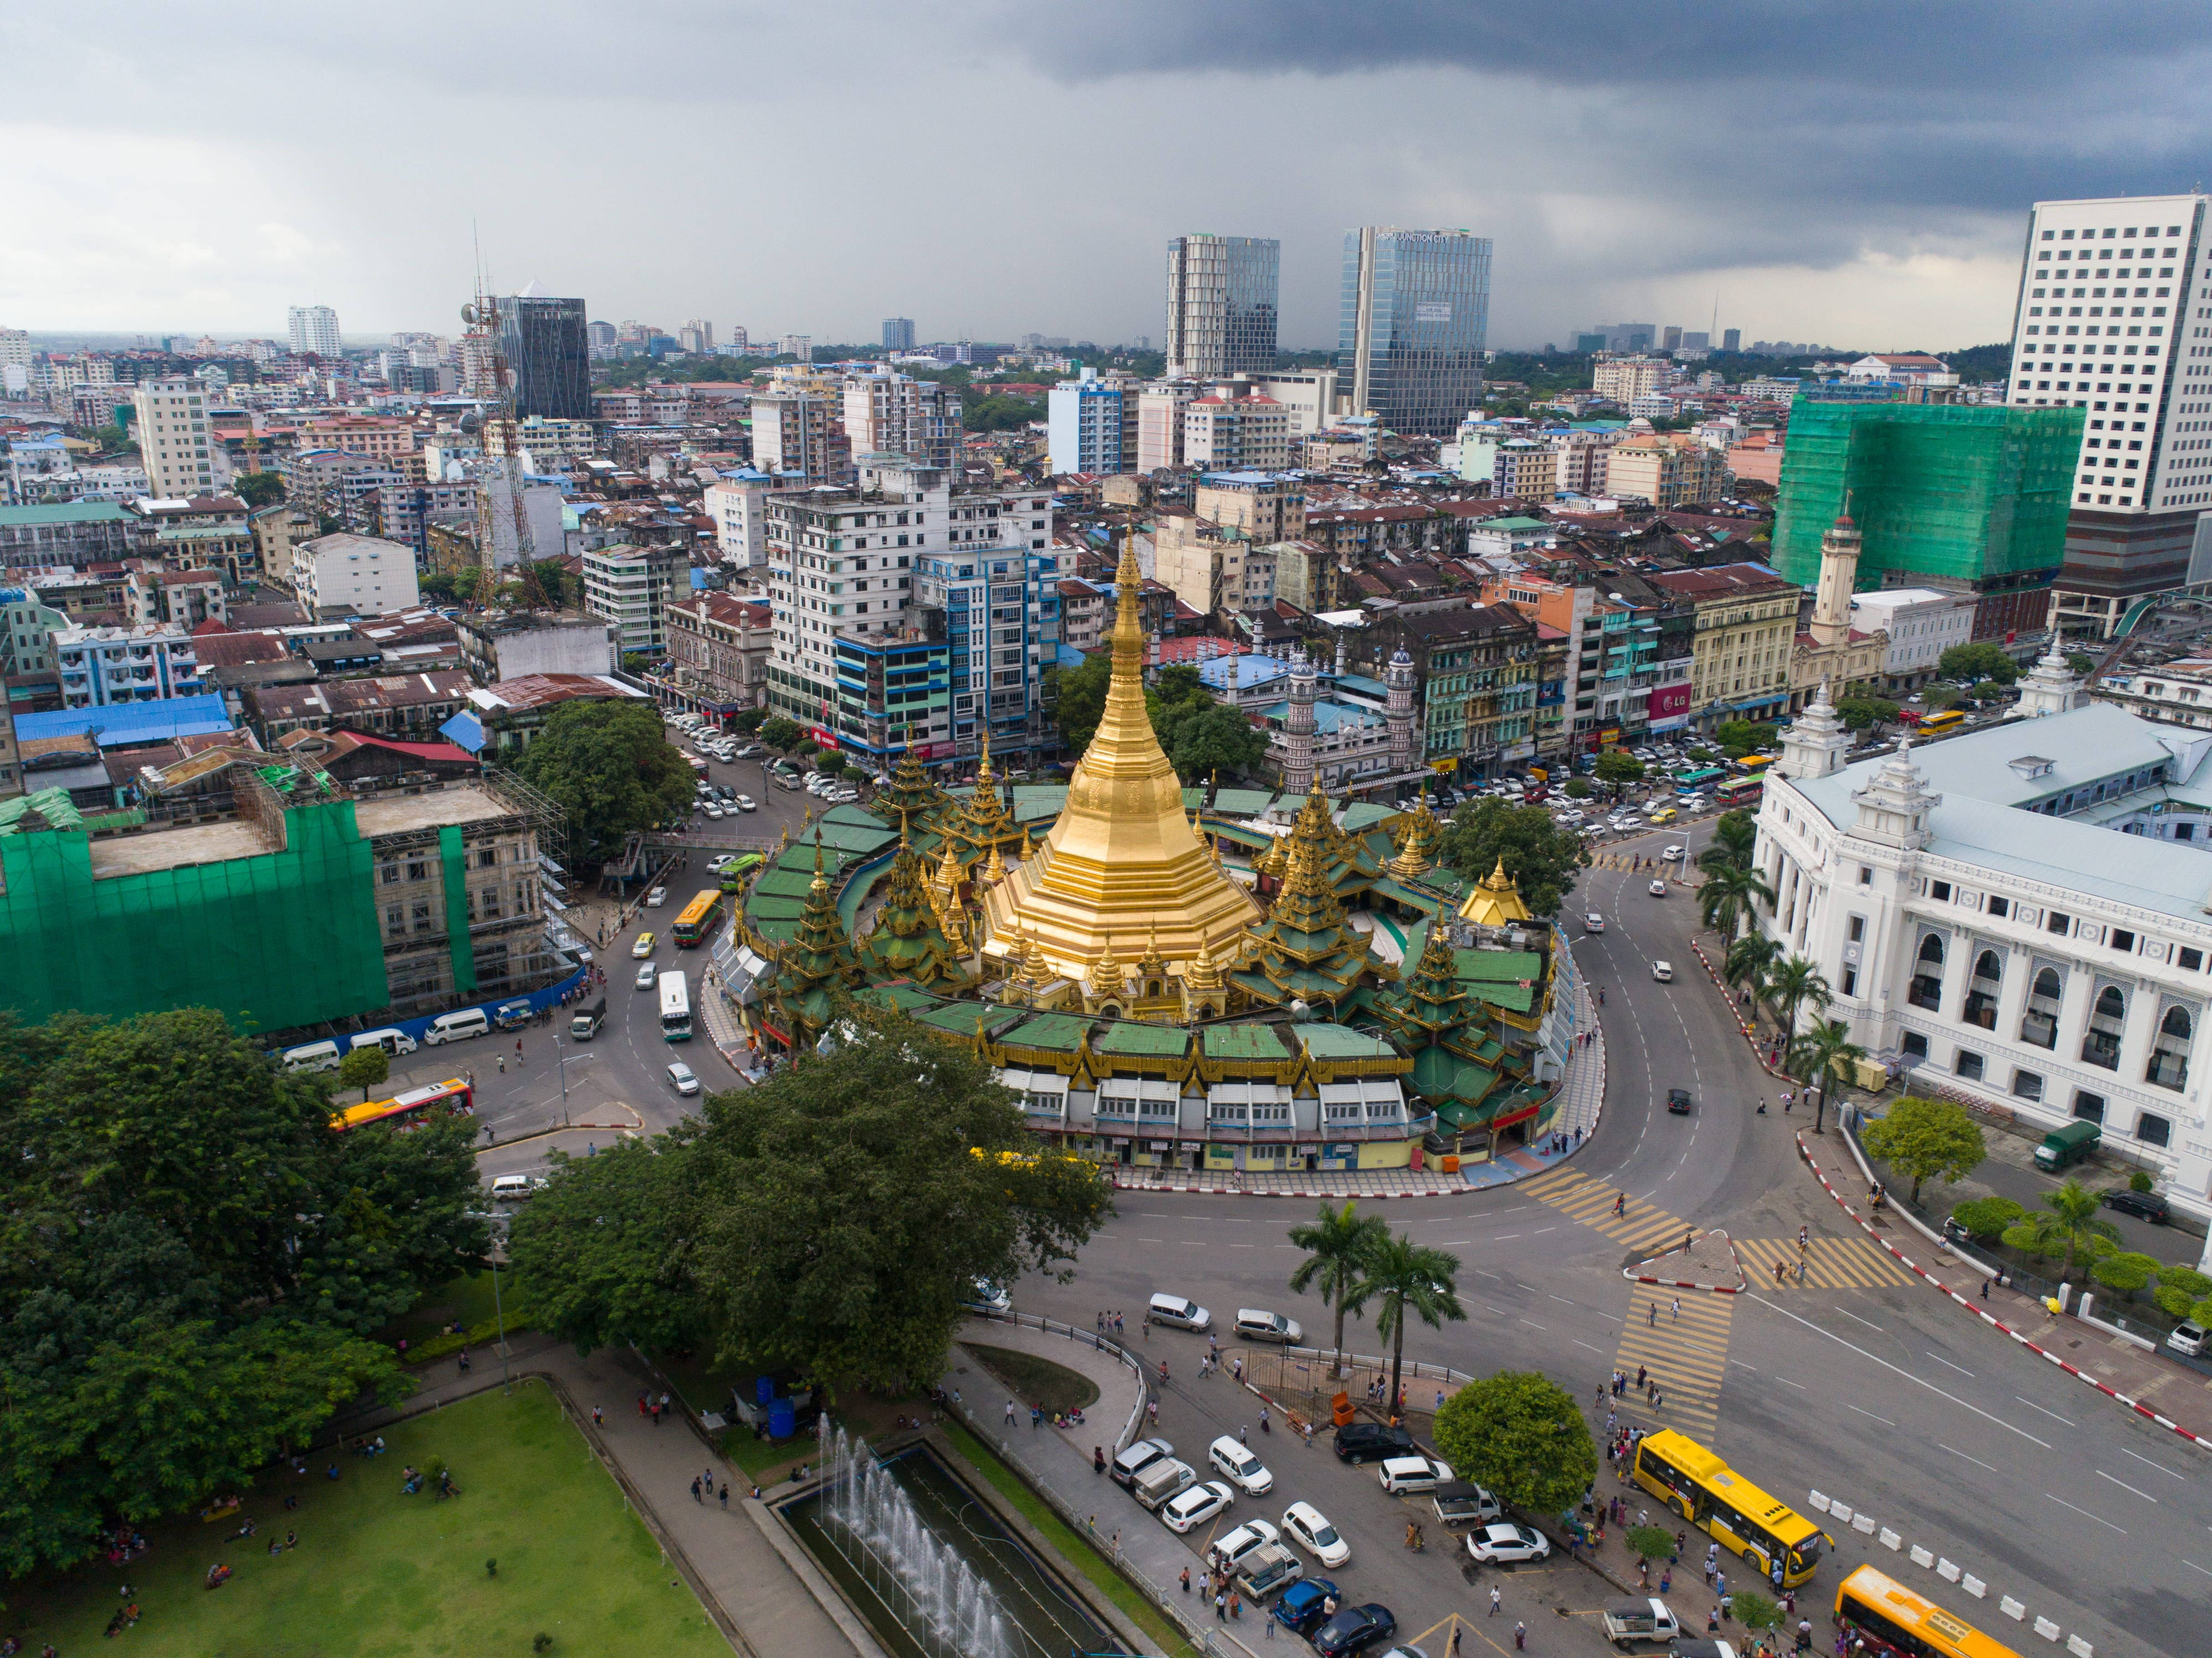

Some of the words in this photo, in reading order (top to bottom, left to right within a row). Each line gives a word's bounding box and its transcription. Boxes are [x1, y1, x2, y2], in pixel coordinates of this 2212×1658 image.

[1398, 233, 1432, 243] JUNCTION
[1434, 235, 1449, 243] CITY
[1674, 696, 1685, 706] LG
[822, 736, 835, 746] HUAWEI
[1805, 1539, 1815, 1547] YBS
